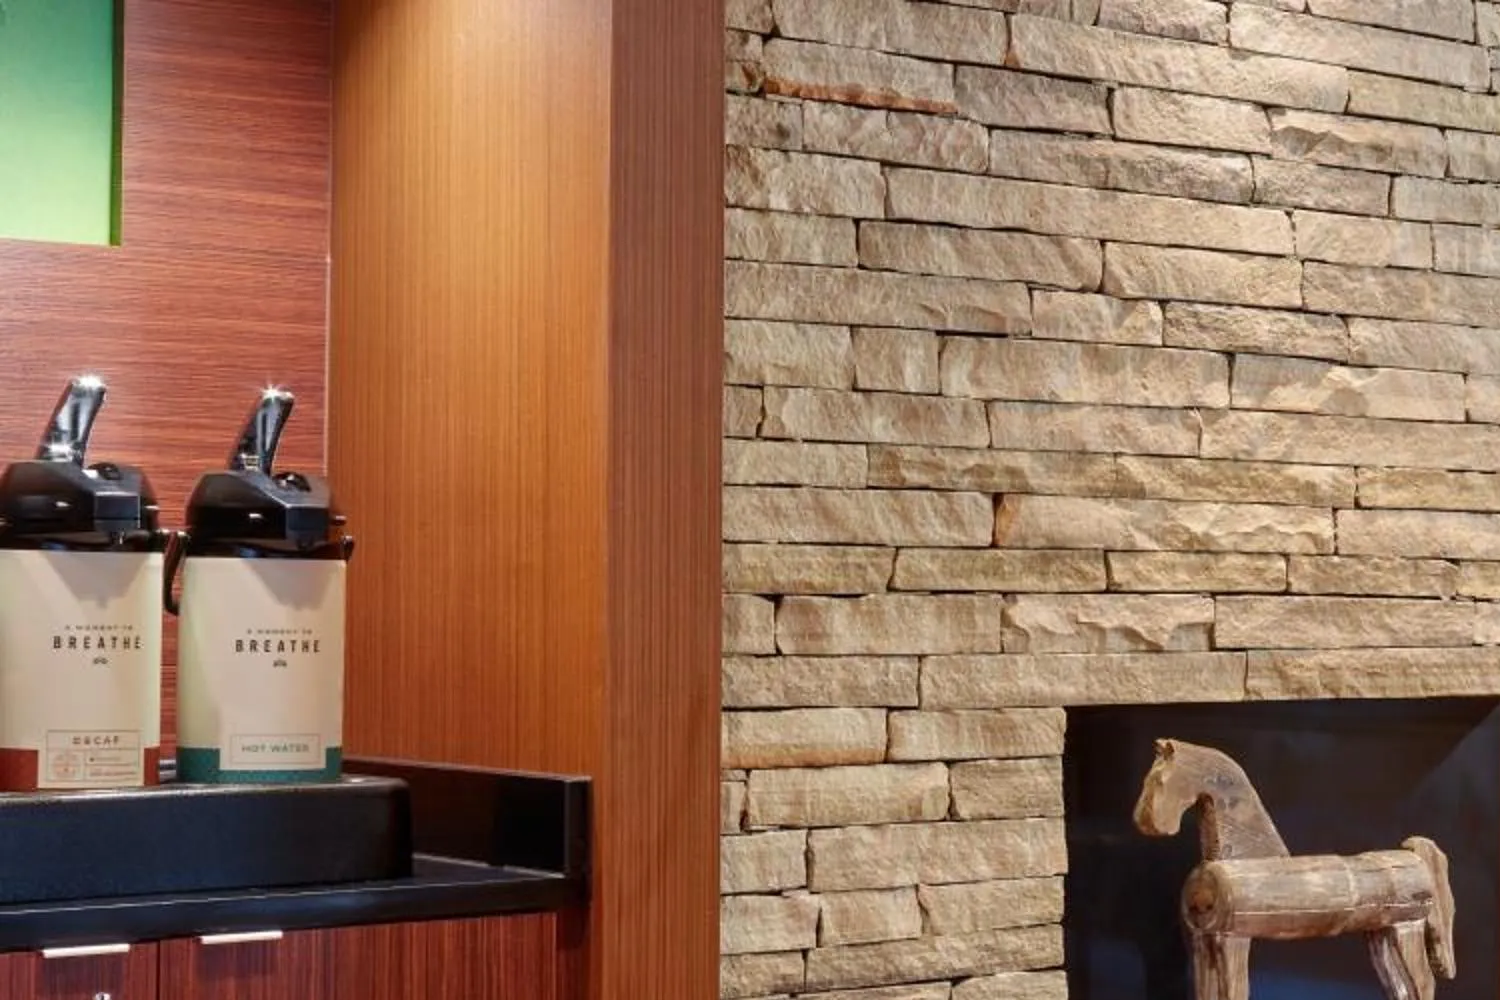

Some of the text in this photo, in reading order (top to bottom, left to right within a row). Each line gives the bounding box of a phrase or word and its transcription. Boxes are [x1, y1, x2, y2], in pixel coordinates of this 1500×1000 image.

[53, 635, 142, 650] BREATHE
[235, 639, 320, 653] BREATHE
[72, 735, 119, 745] DECAF
[271, 743, 310, 753] WATER
